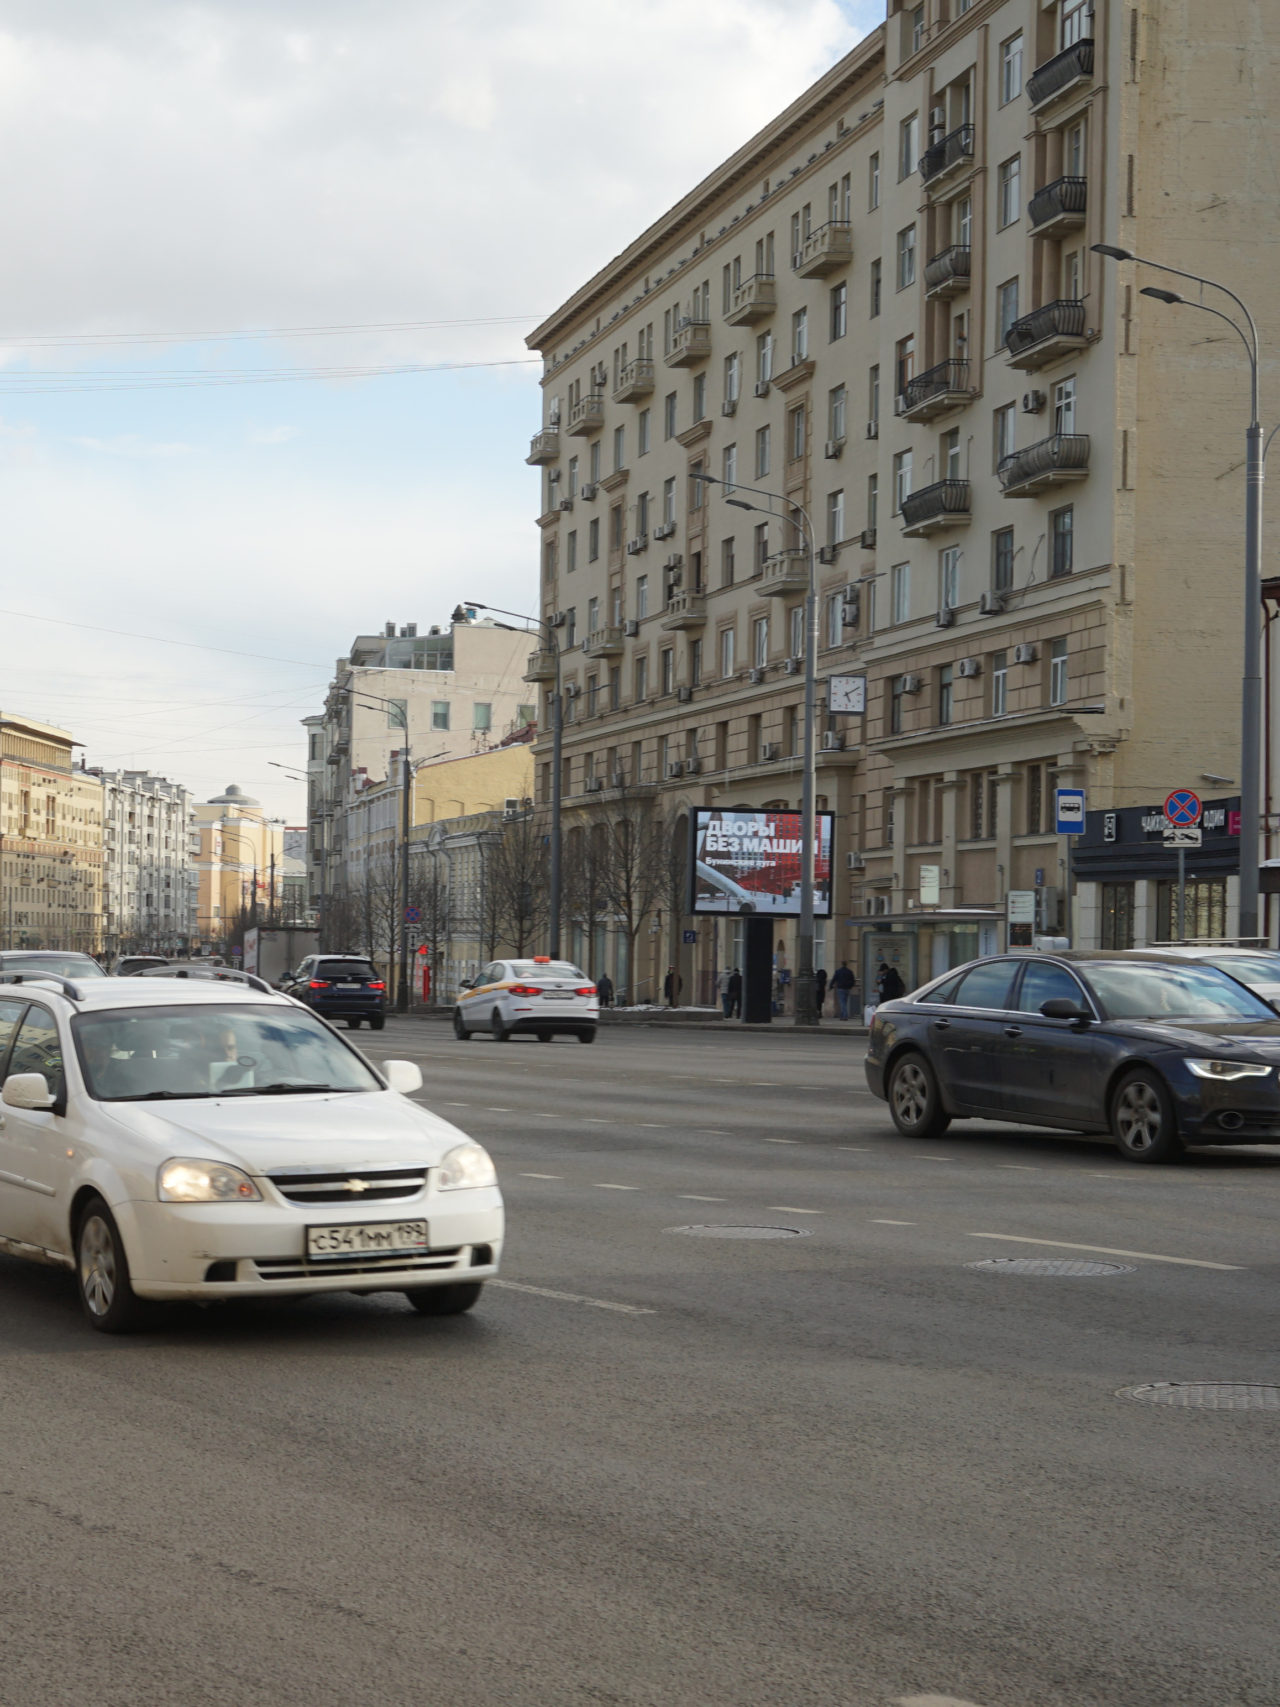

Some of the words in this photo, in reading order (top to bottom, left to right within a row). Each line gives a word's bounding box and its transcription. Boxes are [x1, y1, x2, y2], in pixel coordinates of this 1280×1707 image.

[706, 820, 776, 837] ДВОРЫ
[705, 837, 740, 852] БЕЗ
[315, 1229, 393, 1250] С541ММ
[394, 1223, 423, 1239] 199
